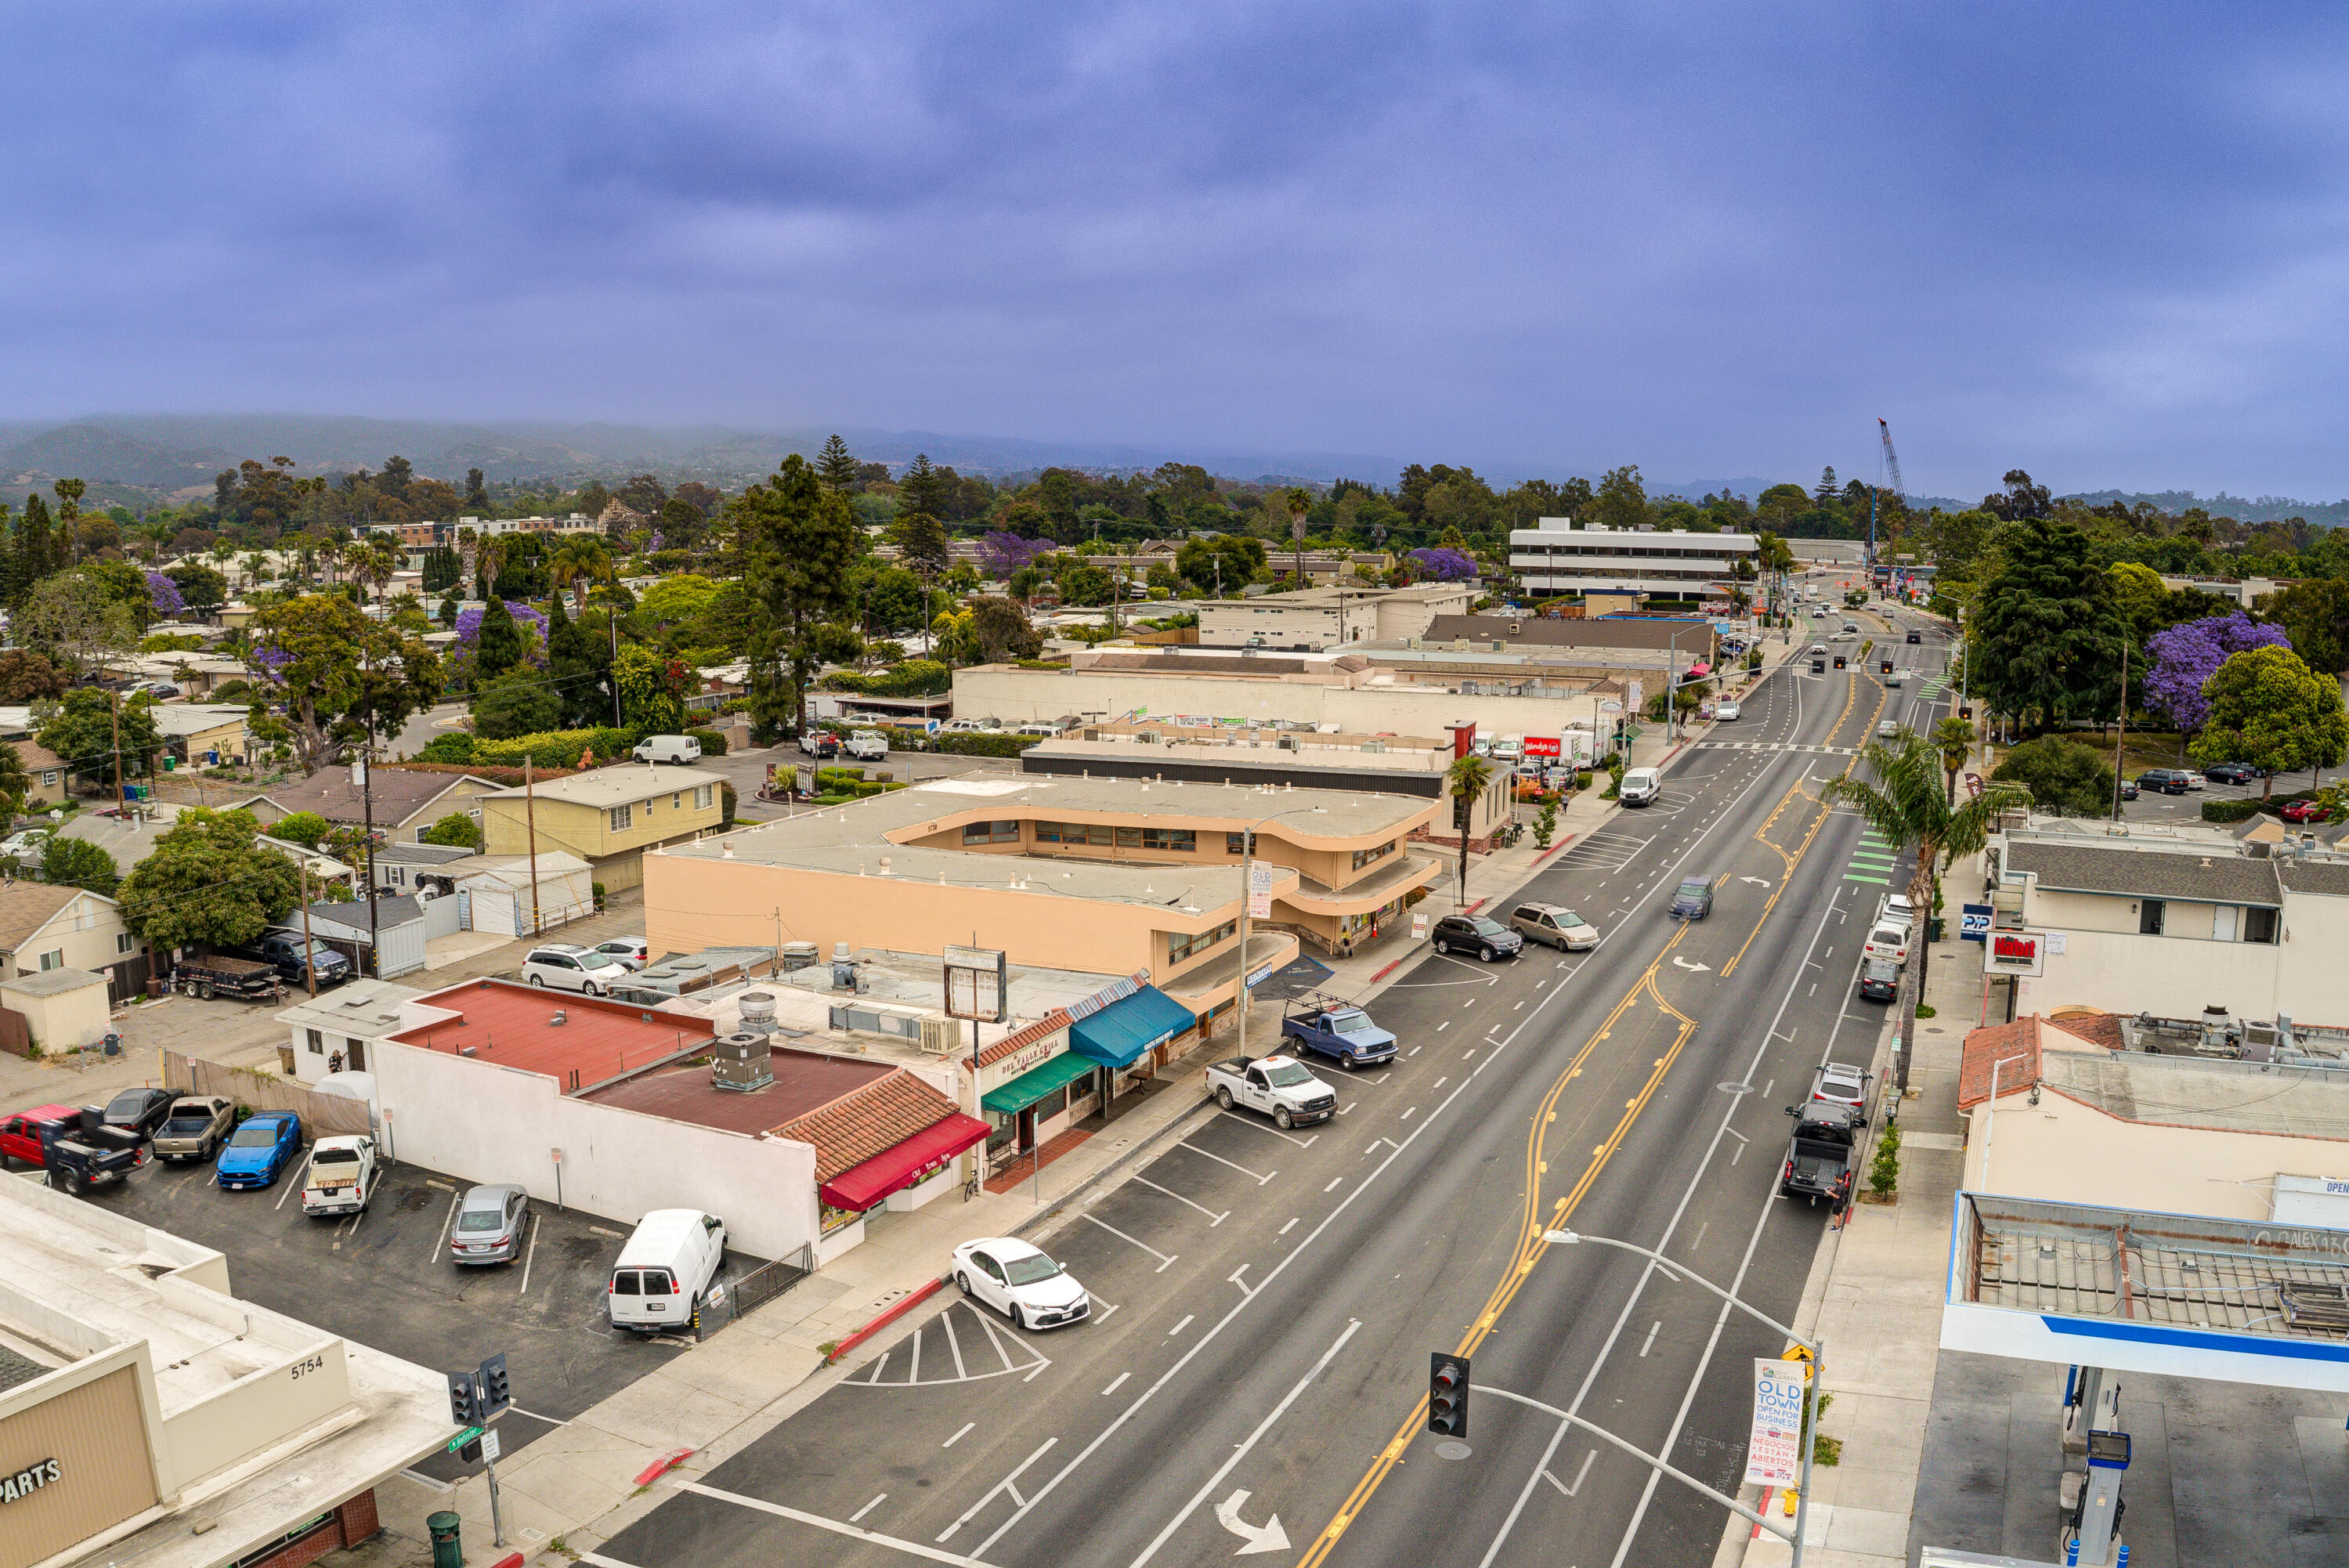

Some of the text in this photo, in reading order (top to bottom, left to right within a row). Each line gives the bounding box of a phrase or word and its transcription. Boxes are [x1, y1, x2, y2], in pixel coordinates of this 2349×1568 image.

[1994, 937, 2036, 958] Habit
[1247, 963, 1272, 984] KENTON
[1002, 1039, 1059, 1074] DEL VALLE GRILL
[1253, 1092, 1267, 1100] MNS
[912, 1153, 951, 1179] Old Town Spa
[2326, 1182, 2349, 1194] OPEN
[291, 1355, 323, 1380] 5754
[1758, 1380, 1801, 1400] OLD
[1758, 1393, 1800, 1411] TOWN
[1756, 1412, 1798, 1429] BUSINESS
[1757, 1405, 1798, 1420] OPEN FOR
[457, 1427, 477, 1446] Hollister
[1753, 1437, 1796, 1451] NEGOCIOS
[1751, 1454, 1794, 1468] ABIERTOS
